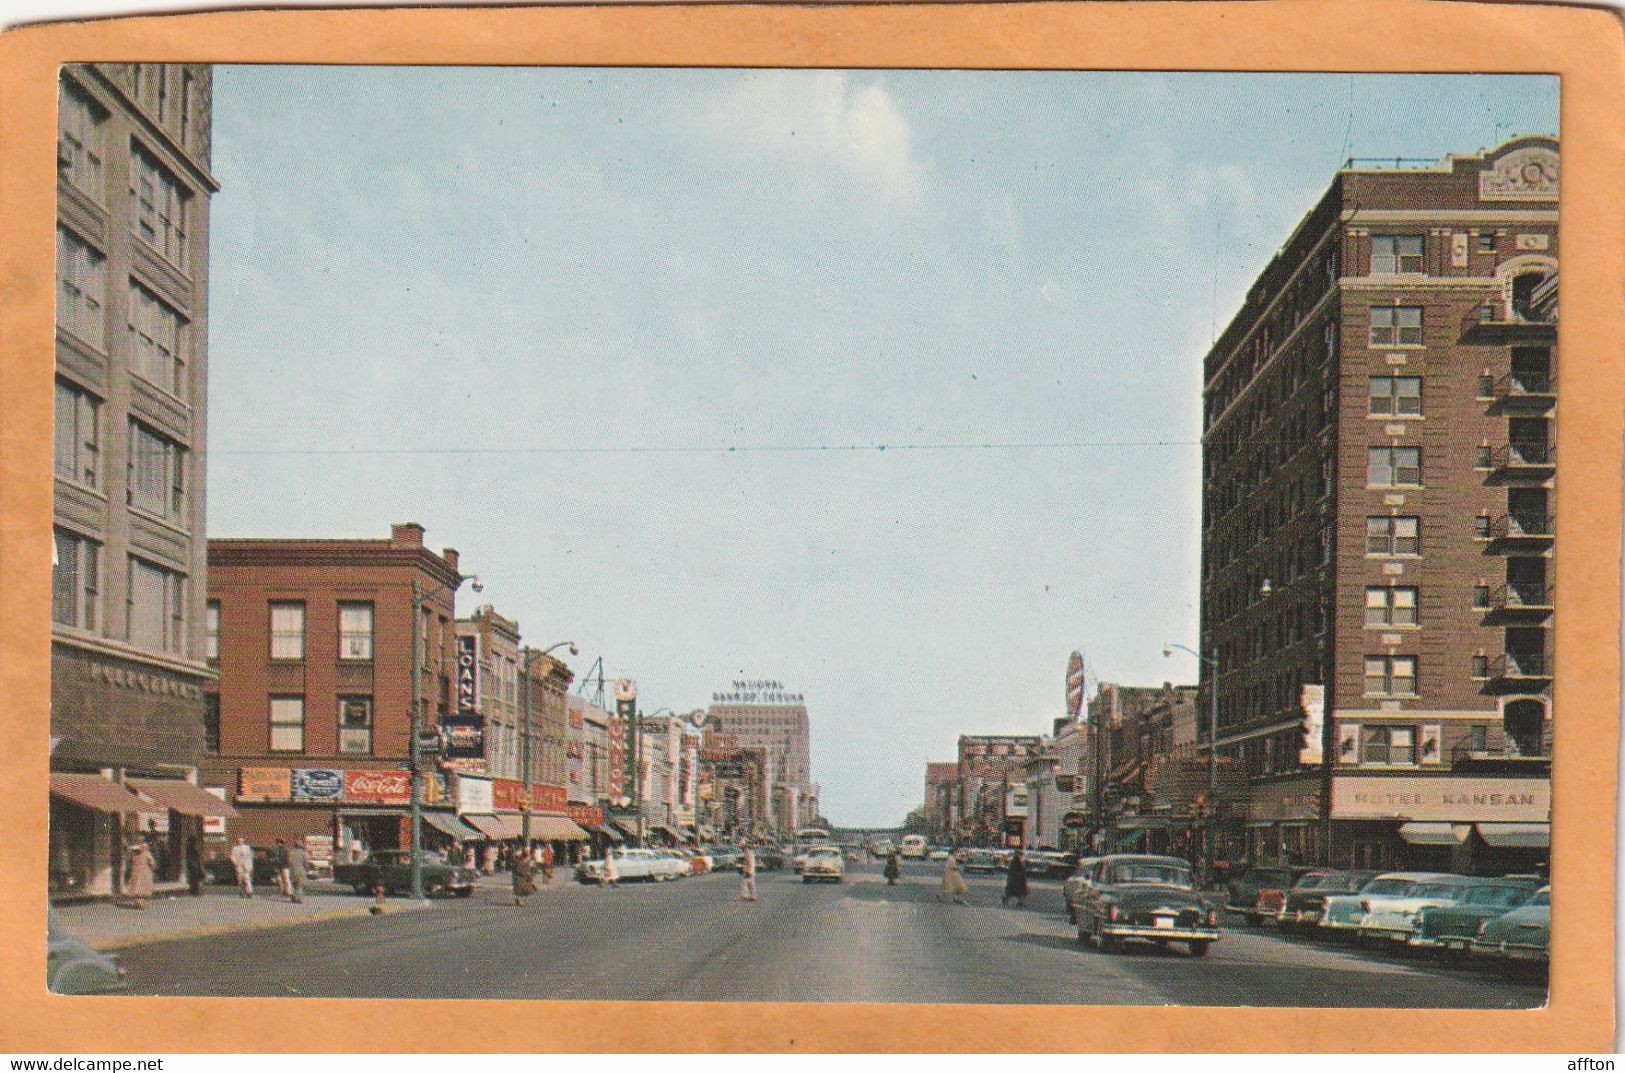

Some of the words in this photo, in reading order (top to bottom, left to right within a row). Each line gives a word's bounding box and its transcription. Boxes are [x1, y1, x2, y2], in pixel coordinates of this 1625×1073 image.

[459, 639, 474, 711] LOANS
[350, 775, 410, 795] Coca-Cola
[1354, 793, 1425, 807] HOTEL
[1442, 793, 1536, 807] KANSAN
